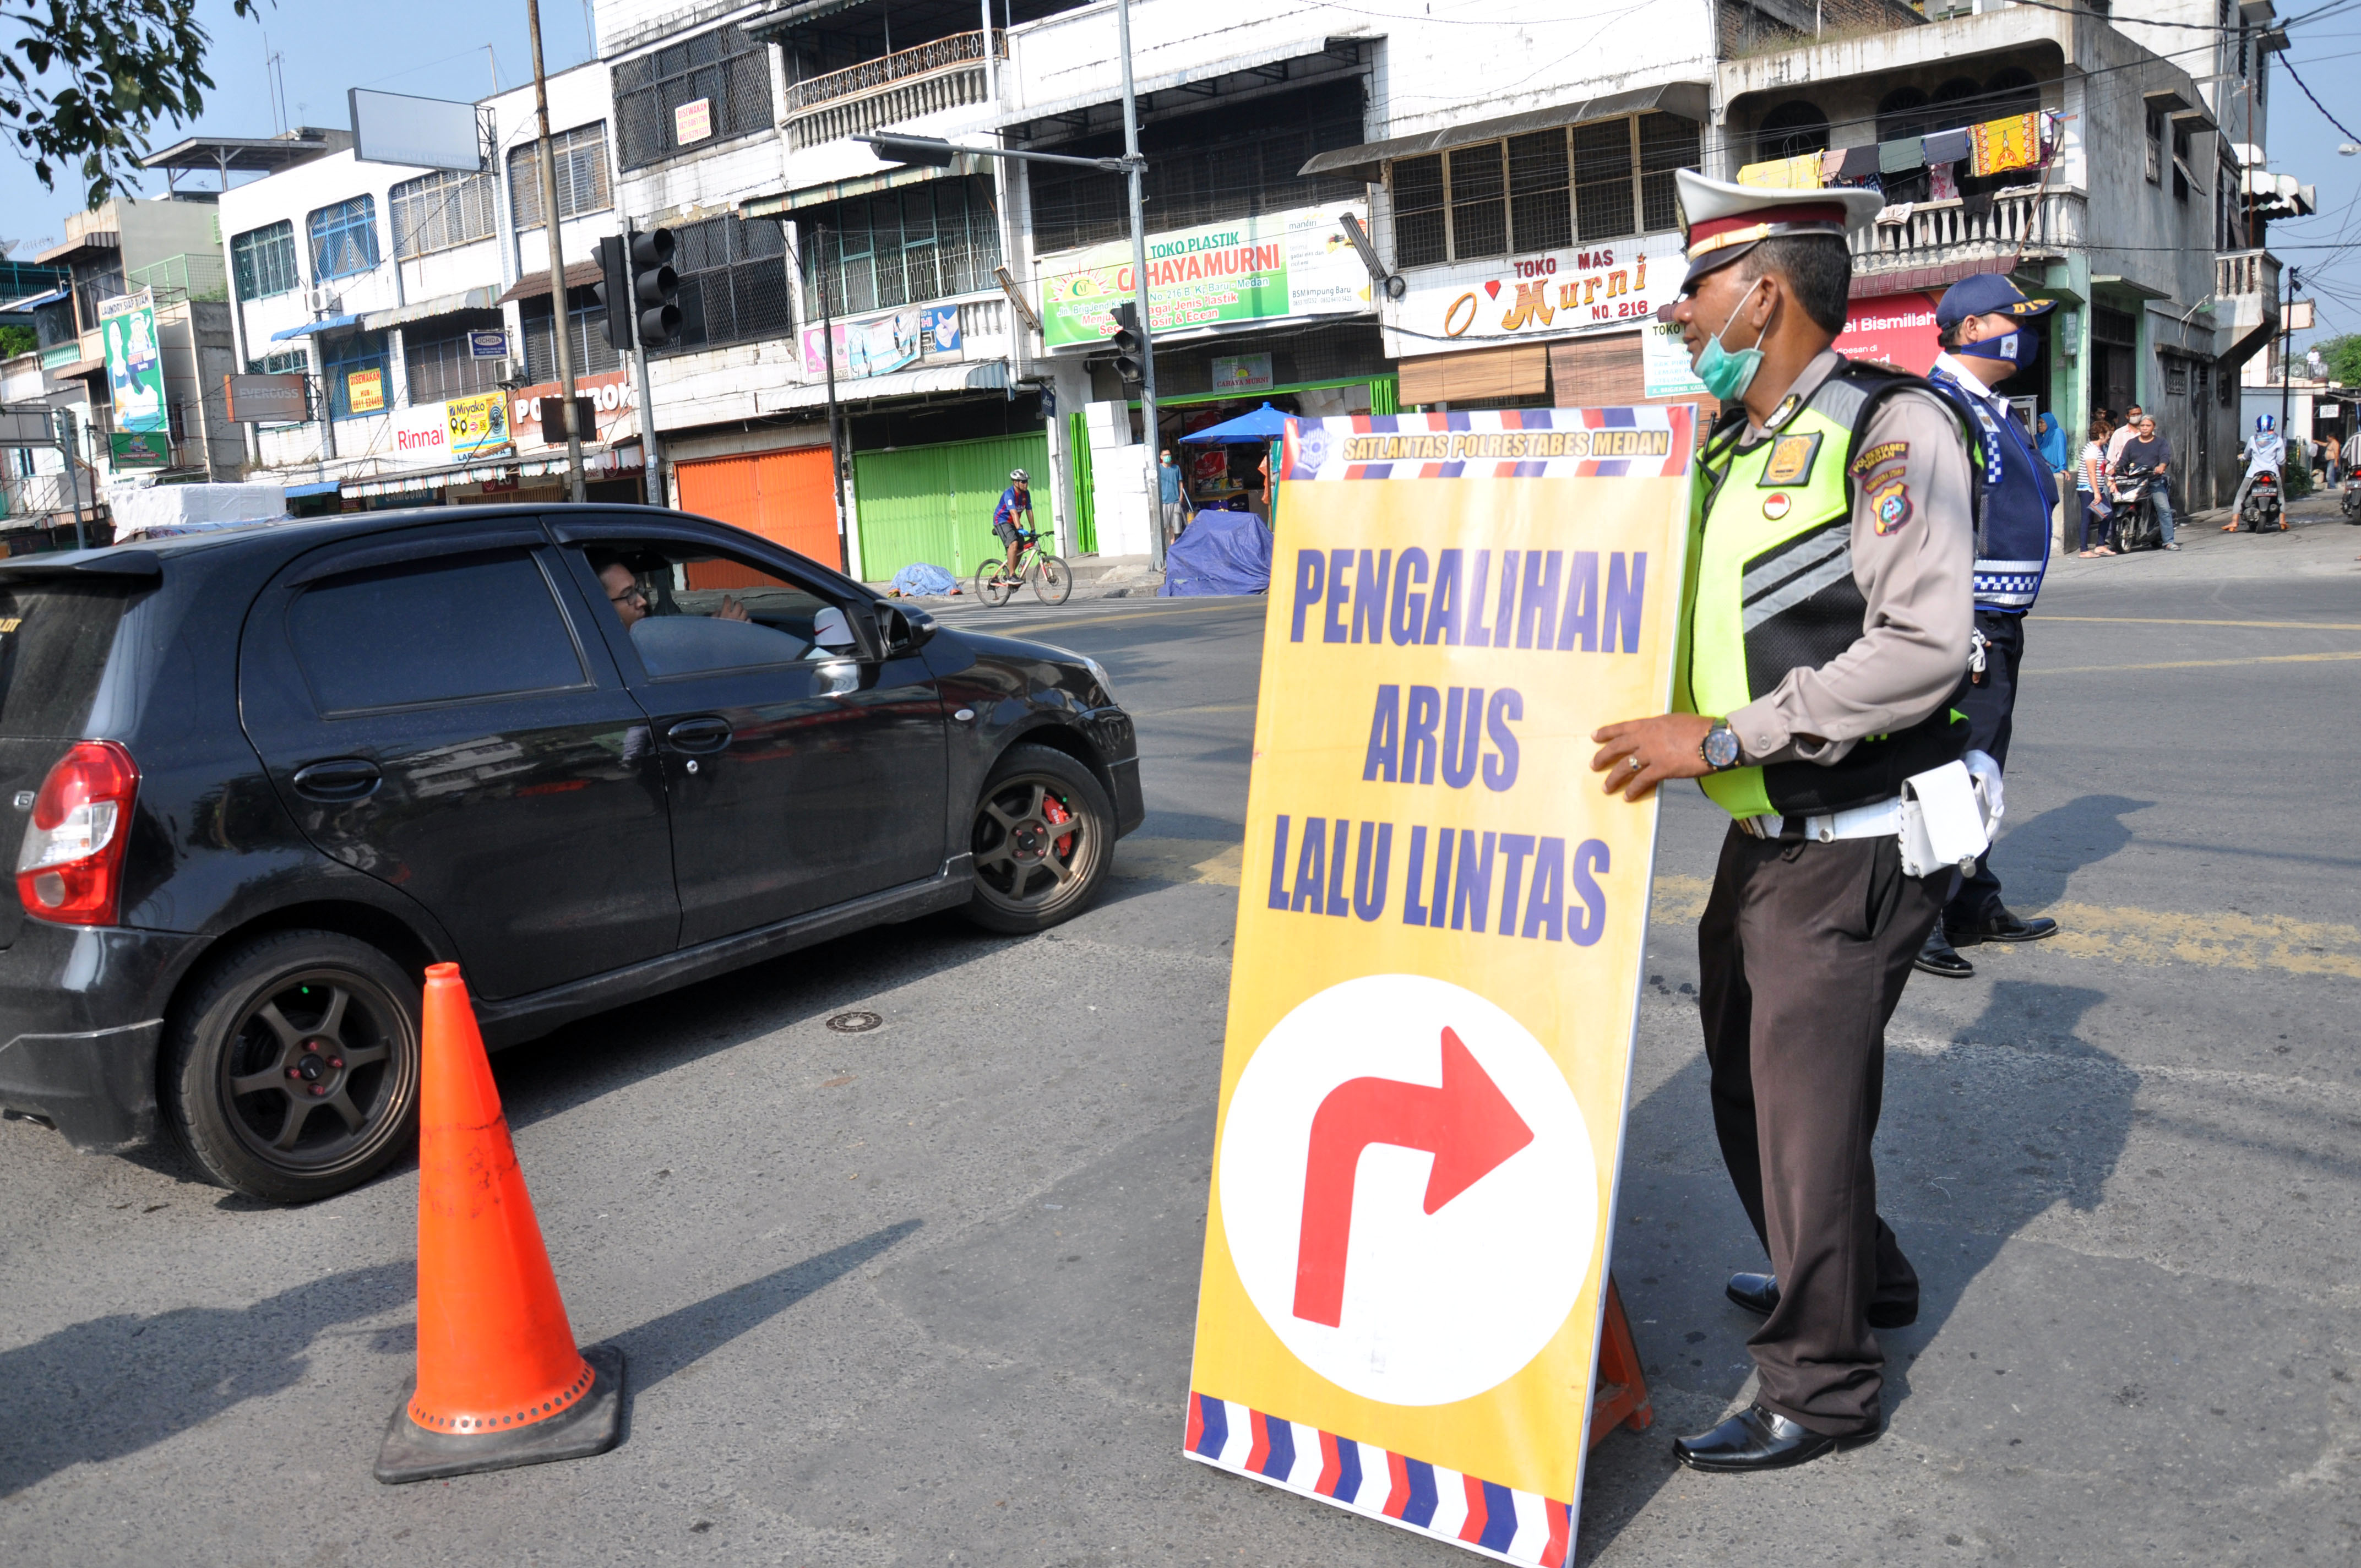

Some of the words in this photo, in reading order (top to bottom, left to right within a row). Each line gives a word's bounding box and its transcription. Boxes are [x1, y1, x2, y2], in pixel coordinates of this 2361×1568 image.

[678, 102, 707, 119] DISEWAKAN
[1150, 241, 1185, 259] TOKO
[1188, 231, 1239, 252] PLASTIK
[1514, 257, 1557, 279] TOKO
[1577, 249, 1614, 270] MAS
[1167, 287, 1182, 299] 216
[1209, 282, 1229, 292] Baru
[1238, 277, 1269, 288] Medan
[1501, 252, 1646, 331] Murni
[101, 303, 123, 315] LAUNDRY
[124, 298, 134, 311] SIAP
[1082, 314, 1117, 324] Menjua
[1174, 299, 1202, 311] Jenis
[1591, 305, 1613, 320] NO.
[1618, 300, 1648, 317] 216
[1176, 313, 1183, 324] &
[1861, 311, 1937, 331] Bismillah
[1652, 324, 1680, 336] TOKO
[350, 371, 380, 386] DISEWAKAN
[1217, 379, 1243, 388] CAHAYA
[1245, 376, 1269, 385] MURNI
[239, 388, 299, 399] EVERCOSS
[456, 400, 485, 417] Miyako
[398, 423, 444, 451] Rinnai
[1343, 434, 1448, 461] SATLANTAS
[1451, 432, 1590, 459] POLRESTABES
[1592, 431, 1669, 456] MEDAN
[1290, 546, 1648, 654] PENGALIHAN
[1362, 684, 1524, 792] ARUS
[1267, 814, 1393, 922] LALU
[1403, 825, 1611, 947] LINTAS
